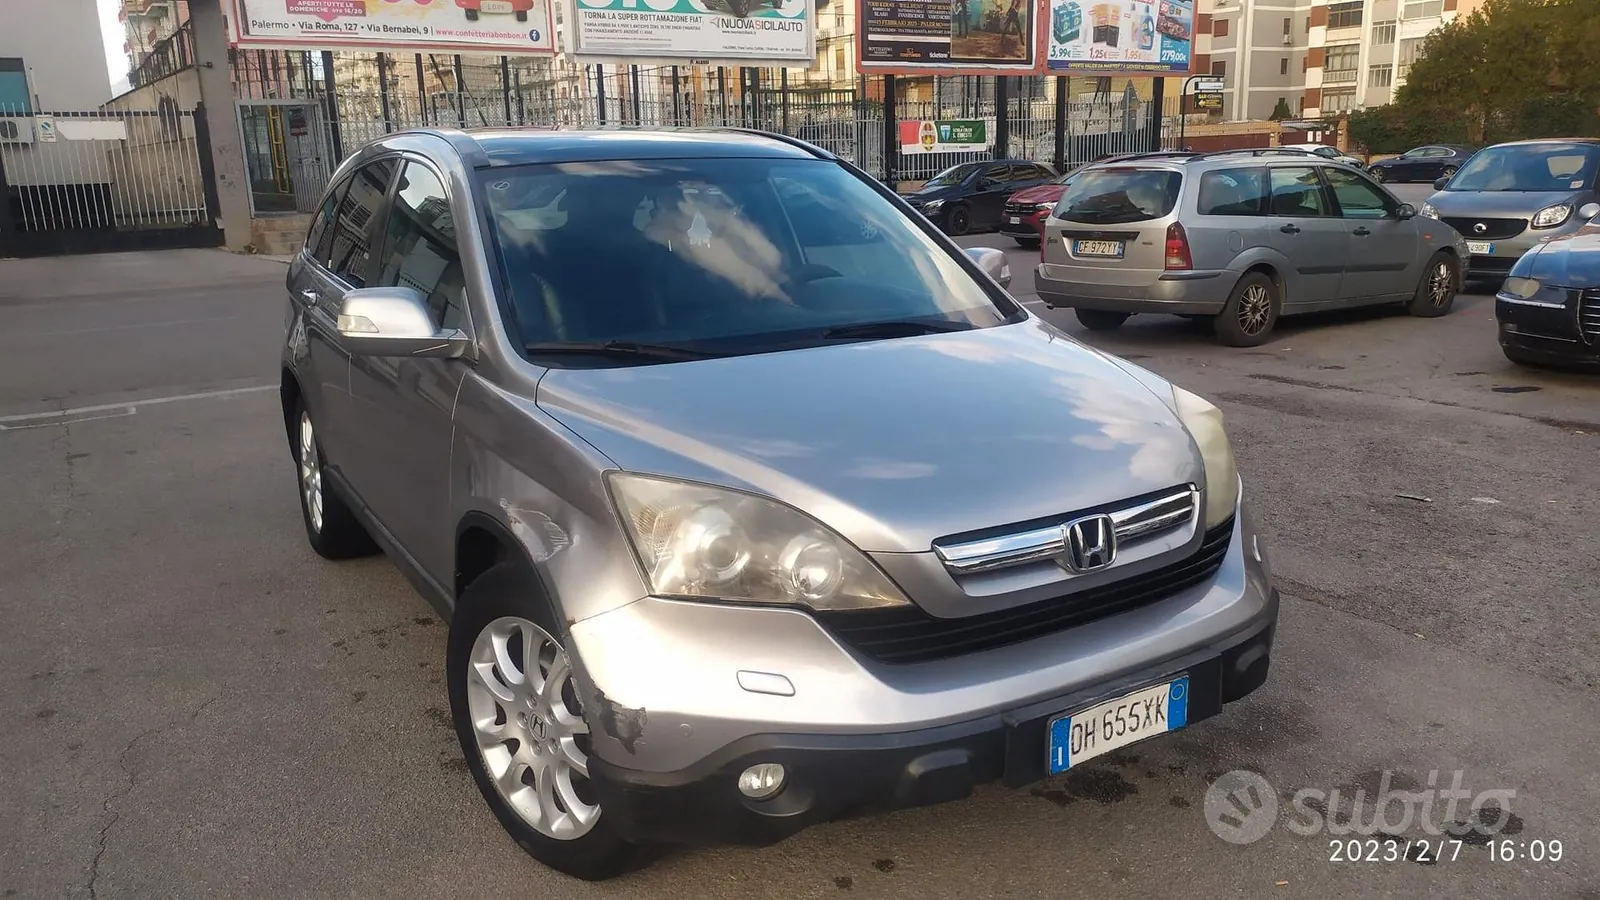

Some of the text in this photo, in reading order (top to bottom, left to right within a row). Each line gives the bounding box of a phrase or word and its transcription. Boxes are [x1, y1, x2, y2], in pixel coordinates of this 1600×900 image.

[584, 11, 606, 19] TORNA
[608, 12, 616, 20] LA
[617, 13, 639, 21] SUPER
[640, 14, 688, 22] ROTTAMAZIONE
[251, 20, 527, 40] Palermo Via Roma, 127 Via Bernabei, 9 www.confetteriabonbon.it
[721, 18, 803, 32] NUOVASICILAUTO
[1050, 45, 1071, 58] 3,99€
[1089, 47, 1107, 59] 1,25€
[1161, 50, 1187, 62] 279,00€
[1078, 241, 1089, 252] CF
[1070, 692, 1168, 755] DH 655XK
